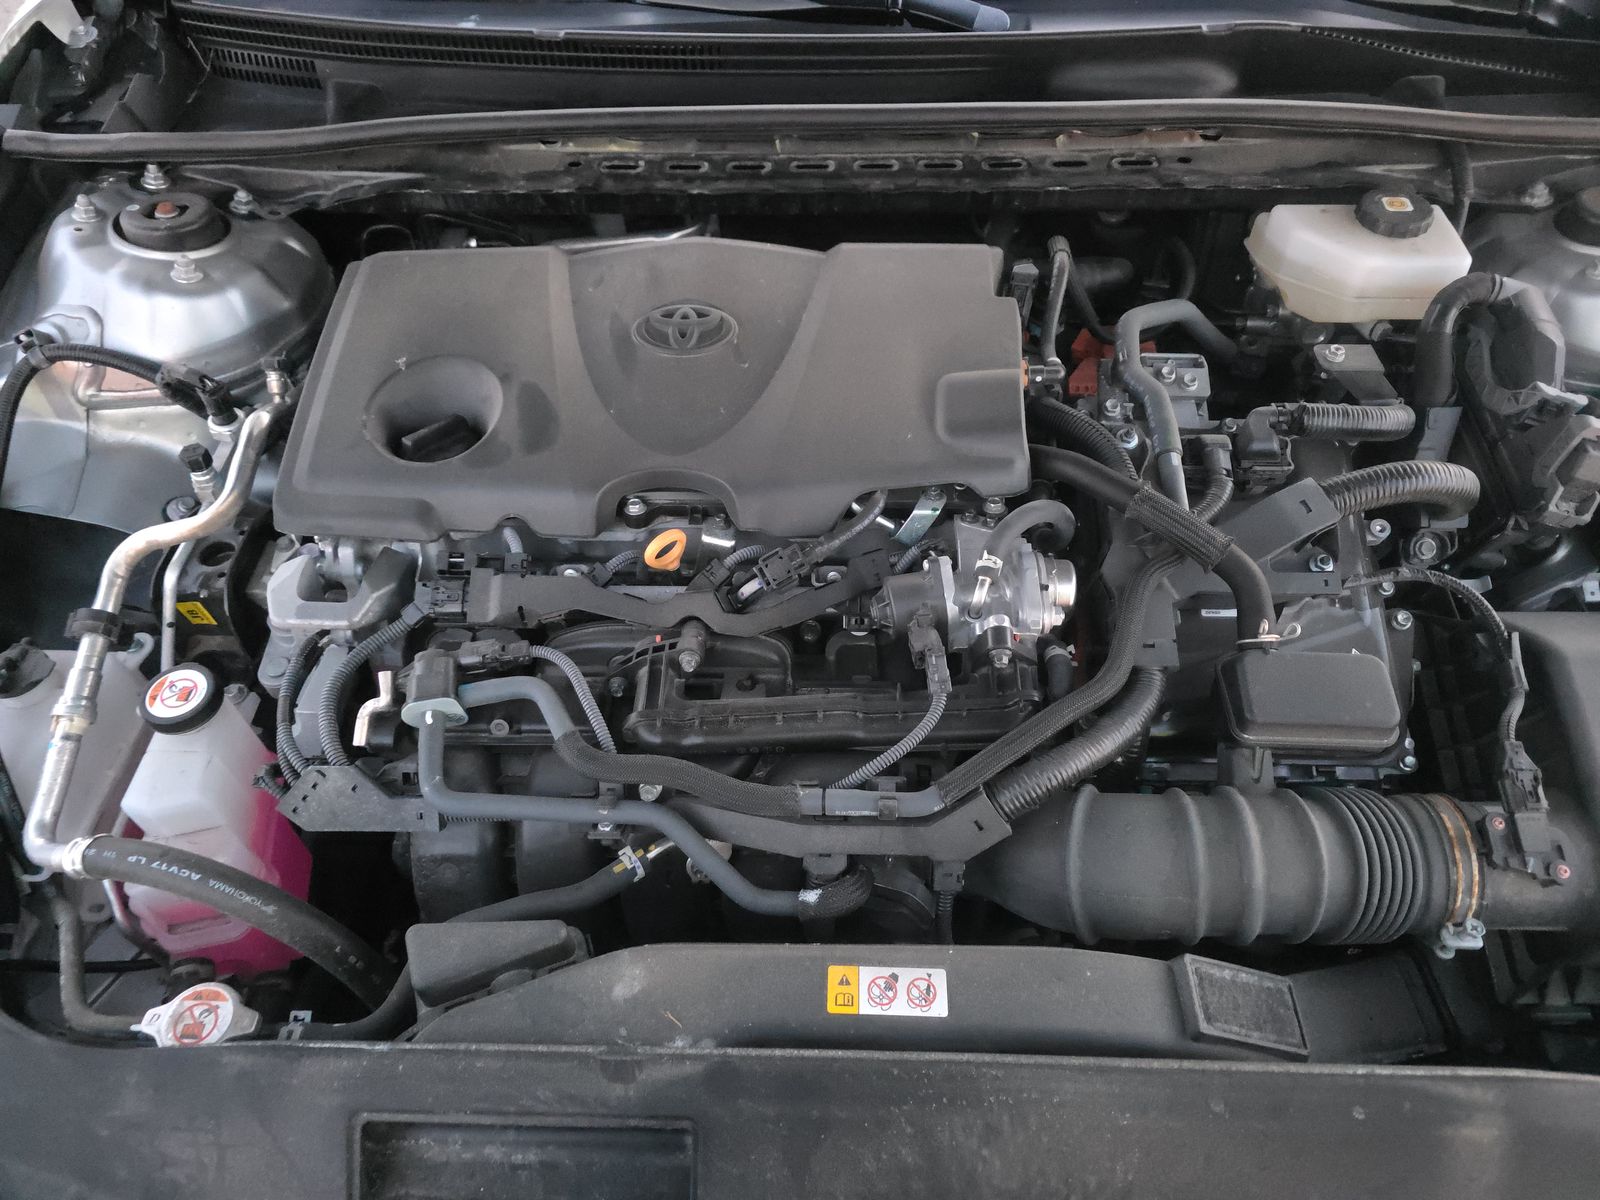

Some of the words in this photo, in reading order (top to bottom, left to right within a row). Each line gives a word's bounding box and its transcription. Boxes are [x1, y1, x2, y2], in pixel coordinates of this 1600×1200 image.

[126, 854, 147, 866] LP
[150, 860, 202, 881] ACV17
[208, 878, 263, 908] YOKOHAMA
